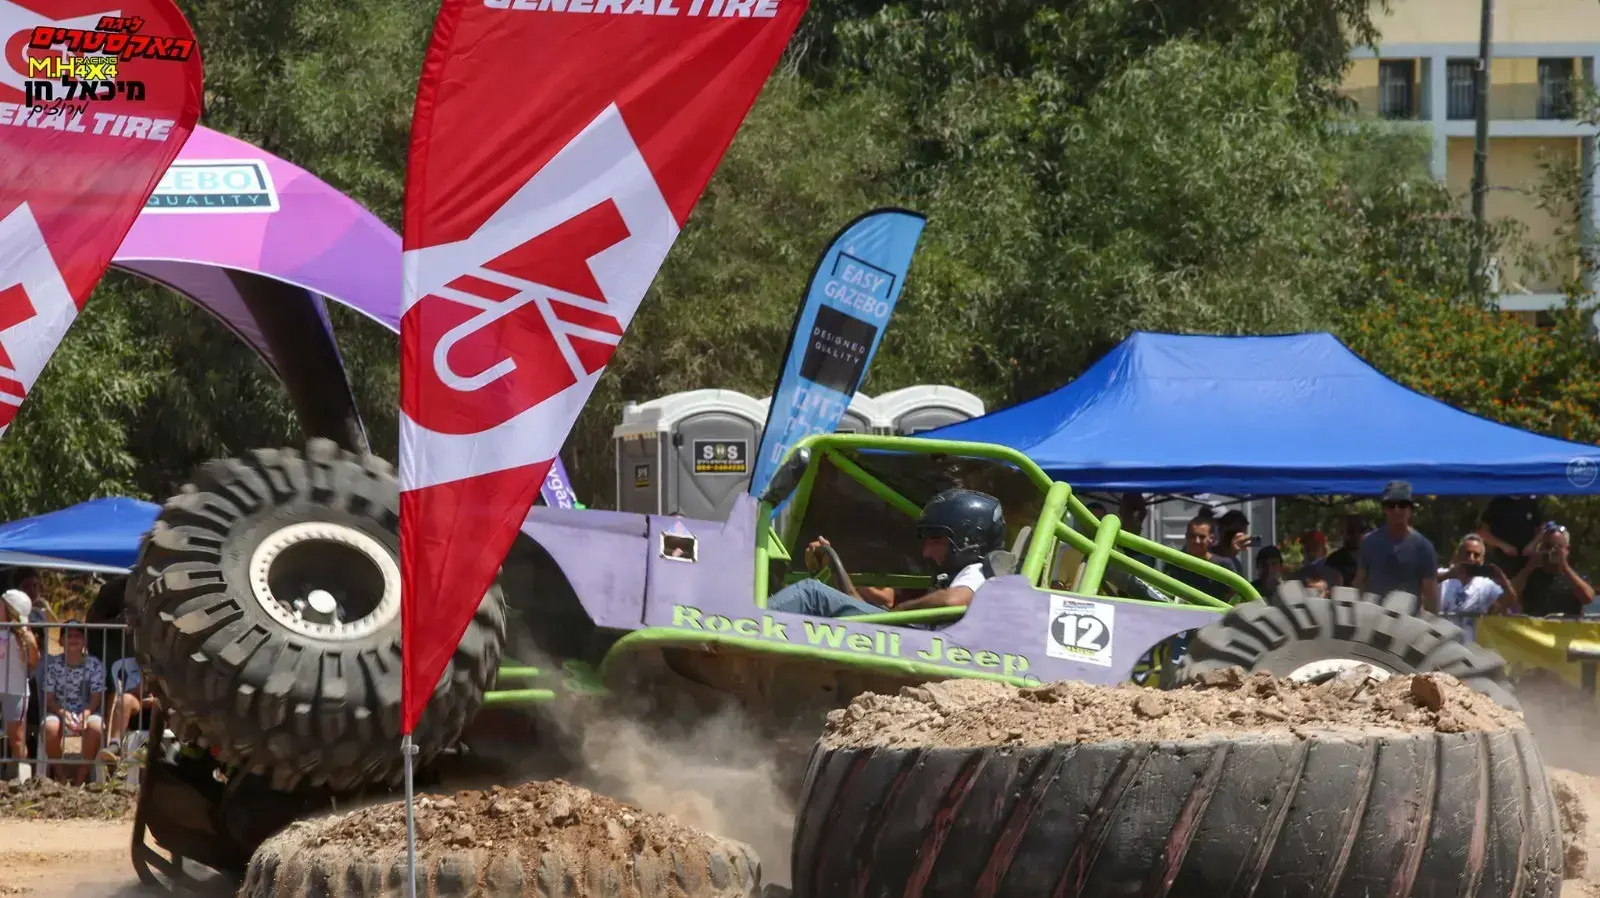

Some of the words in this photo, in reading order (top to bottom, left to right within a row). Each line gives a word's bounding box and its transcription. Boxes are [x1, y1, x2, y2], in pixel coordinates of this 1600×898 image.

[93, 112, 175, 141] TIRE
[148, 195, 260, 206] QUALITY
[842, 264, 885, 293] EASY
[824, 280, 889, 318] GAZEBO
[813, 327, 865, 354] DESIGNED
[815, 341, 860, 364] QUALITY
[672, 604, 790, 641] Rock
[803, 620, 900, 657] Well
[917, 637, 1031, 677] Jeep
[1057, 615, 1104, 652] 12
